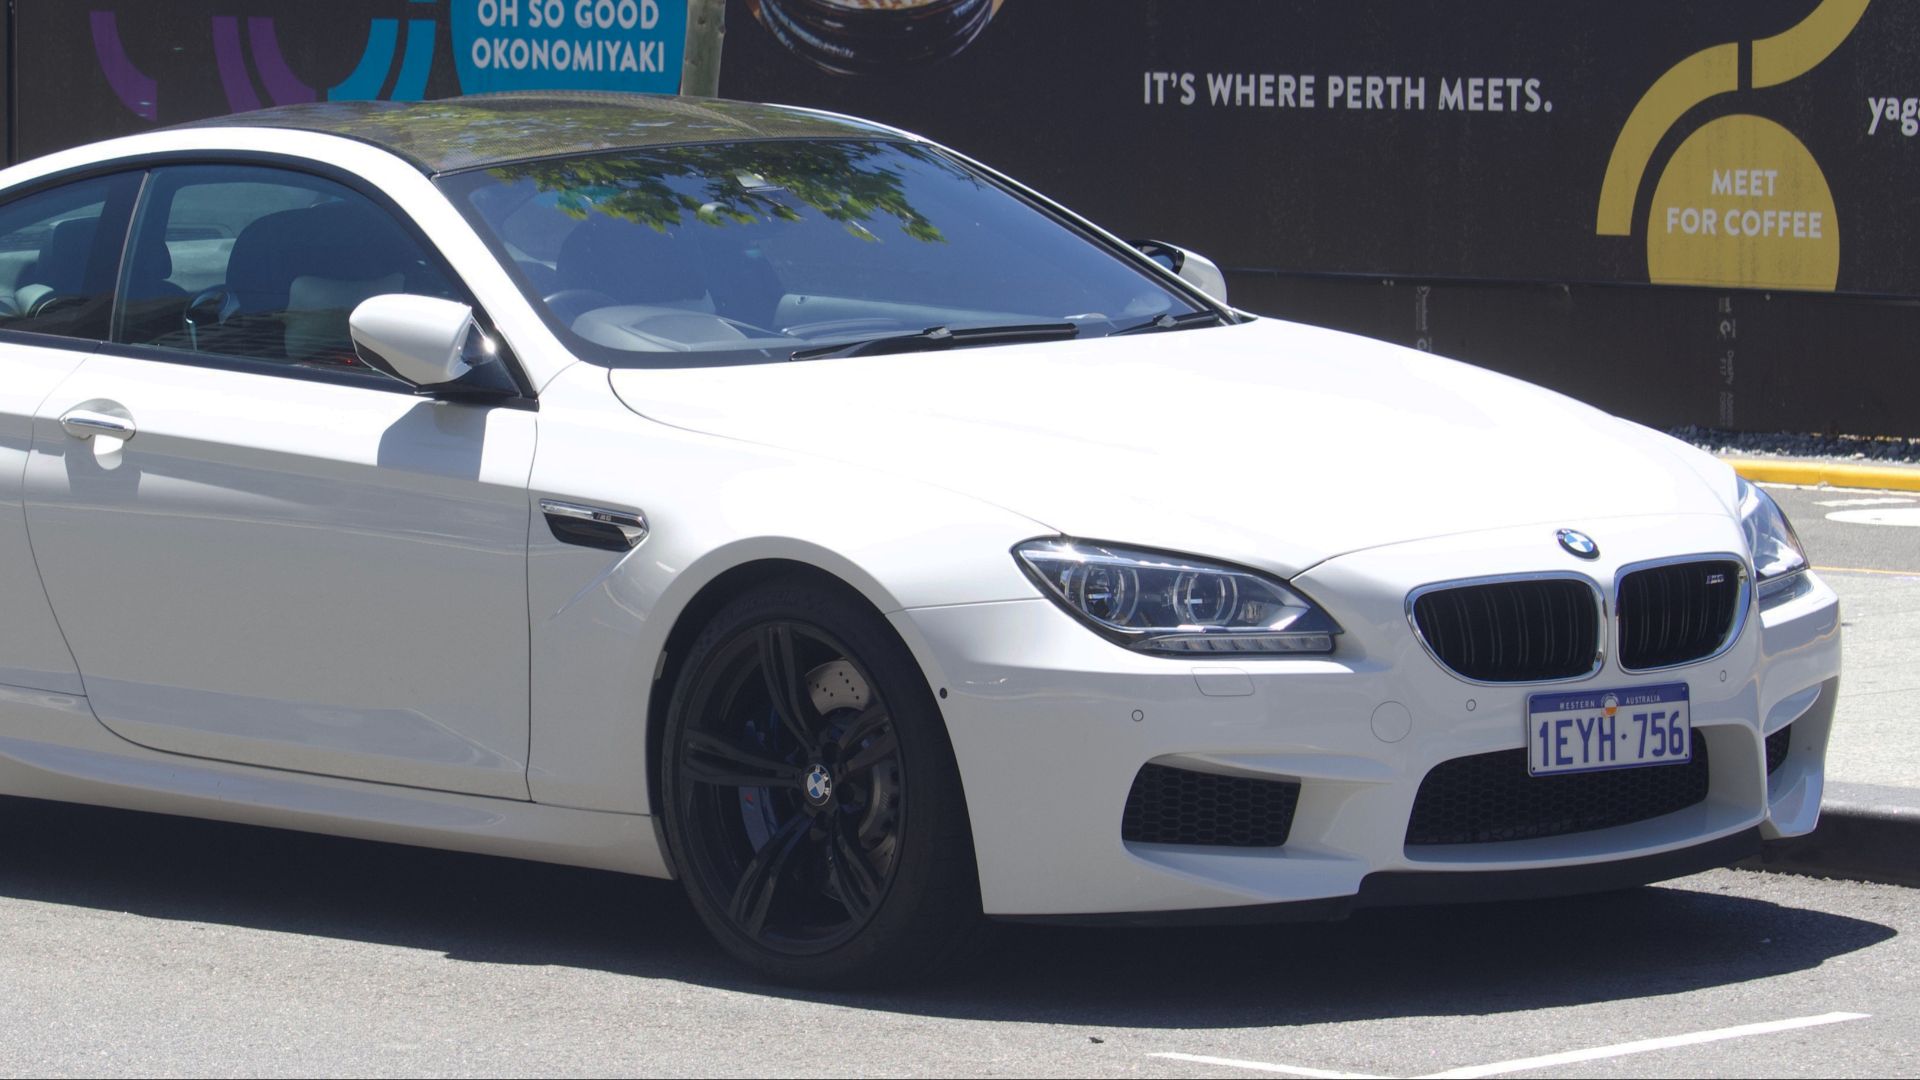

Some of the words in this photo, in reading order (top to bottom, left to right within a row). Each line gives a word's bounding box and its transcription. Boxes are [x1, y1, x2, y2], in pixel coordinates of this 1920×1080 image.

[477, 0, 518, 27] OH
[528, 0, 565, 28] SO
[574, 0, 660, 29] GOOD
[471, 37, 665, 72] OKONOMIYAKI
[1144, 72, 1196, 106] IT'S
[1206, 73, 1315, 108] WHERE
[1327, 75, 1425, 110] PERTH
[1438, 77, 1553, 113] MEETS.
[1867, 97, 1920, 137] yag
[1711, 169, 1778, 196] MEET
[1666, 207, 1717, 235] FOR
[1724, 209, 1823, 239] COFFEE
[1559, 700, 1595, 710] WESTERN
[1625, 694, 1661, 705] AUSTRALIA
